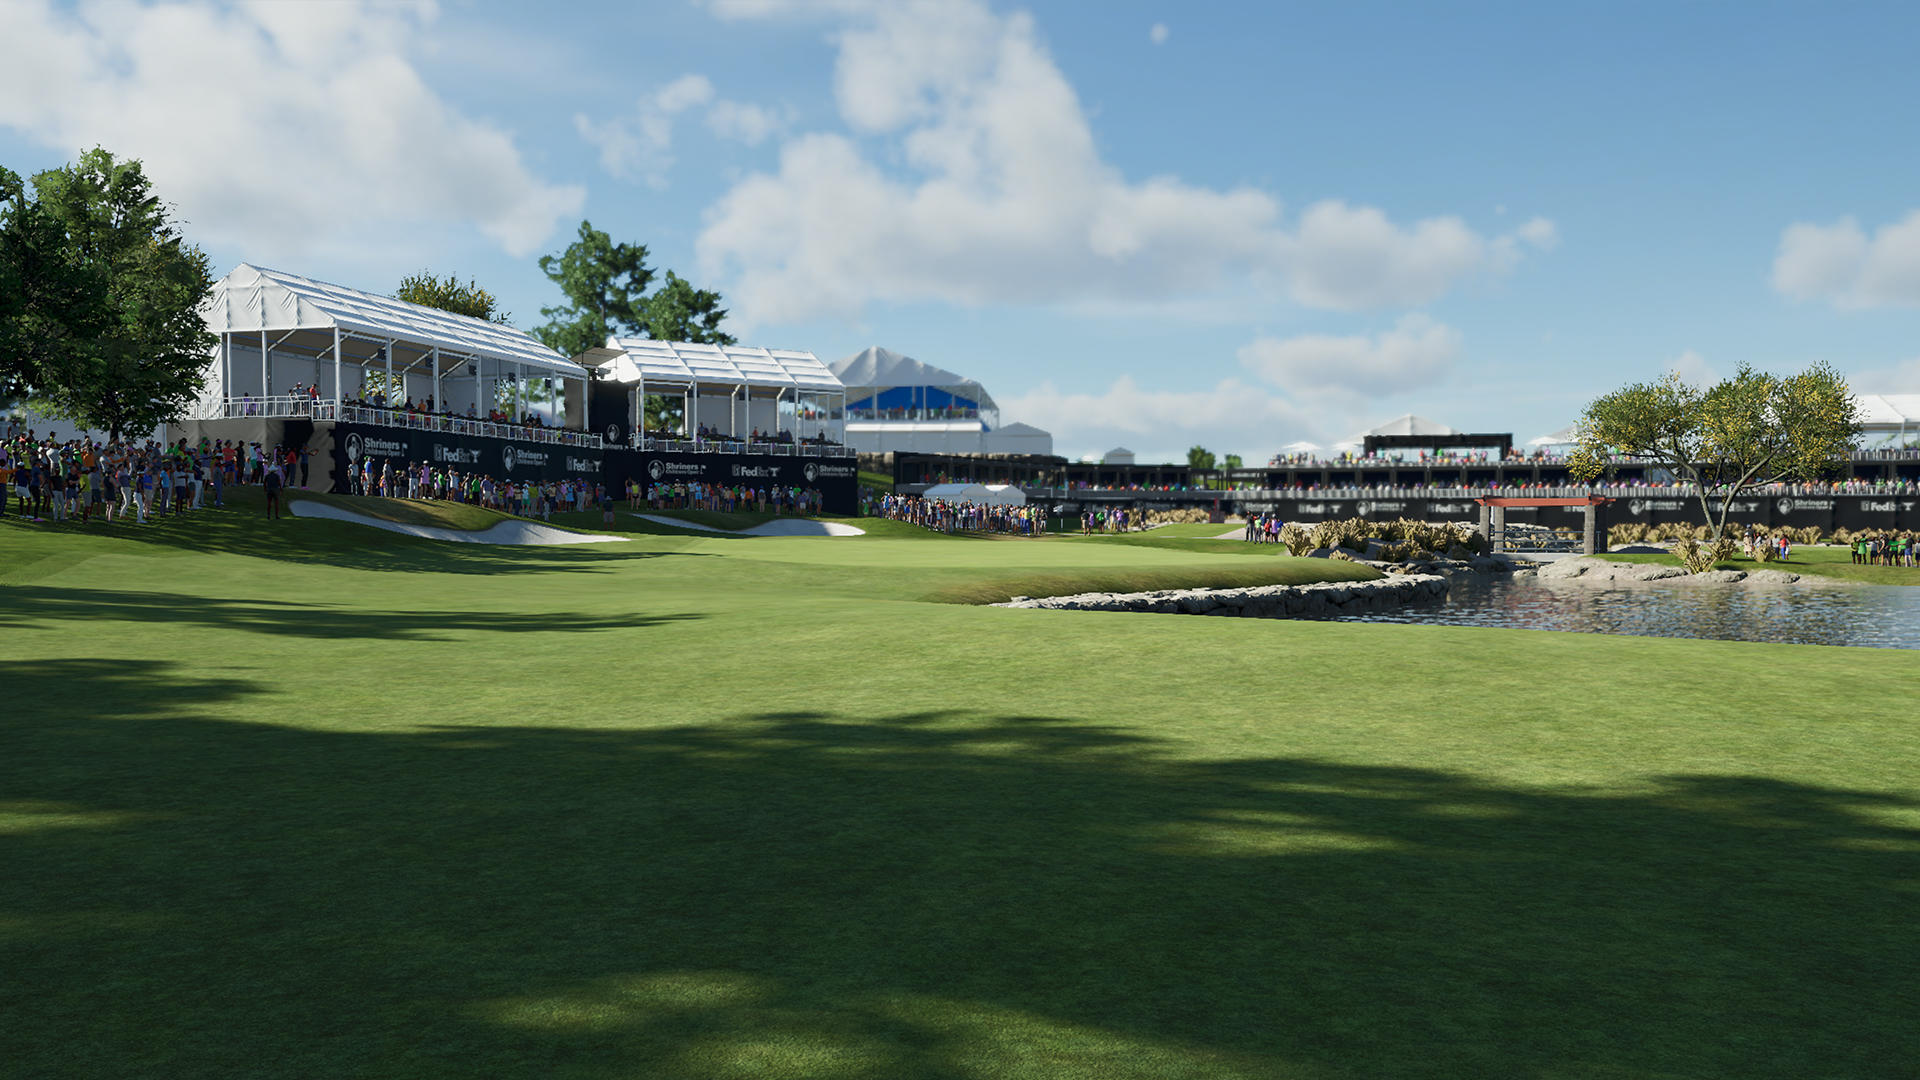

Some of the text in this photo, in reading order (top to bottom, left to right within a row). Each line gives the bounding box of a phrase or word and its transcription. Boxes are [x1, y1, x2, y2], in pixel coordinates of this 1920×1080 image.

[364, 437, 400, 450] Shriners
[443, 447, 470, 463] FedEx
[517, 449, 542, 459] Shriners
[665, 462, 698, 471] Shriners
